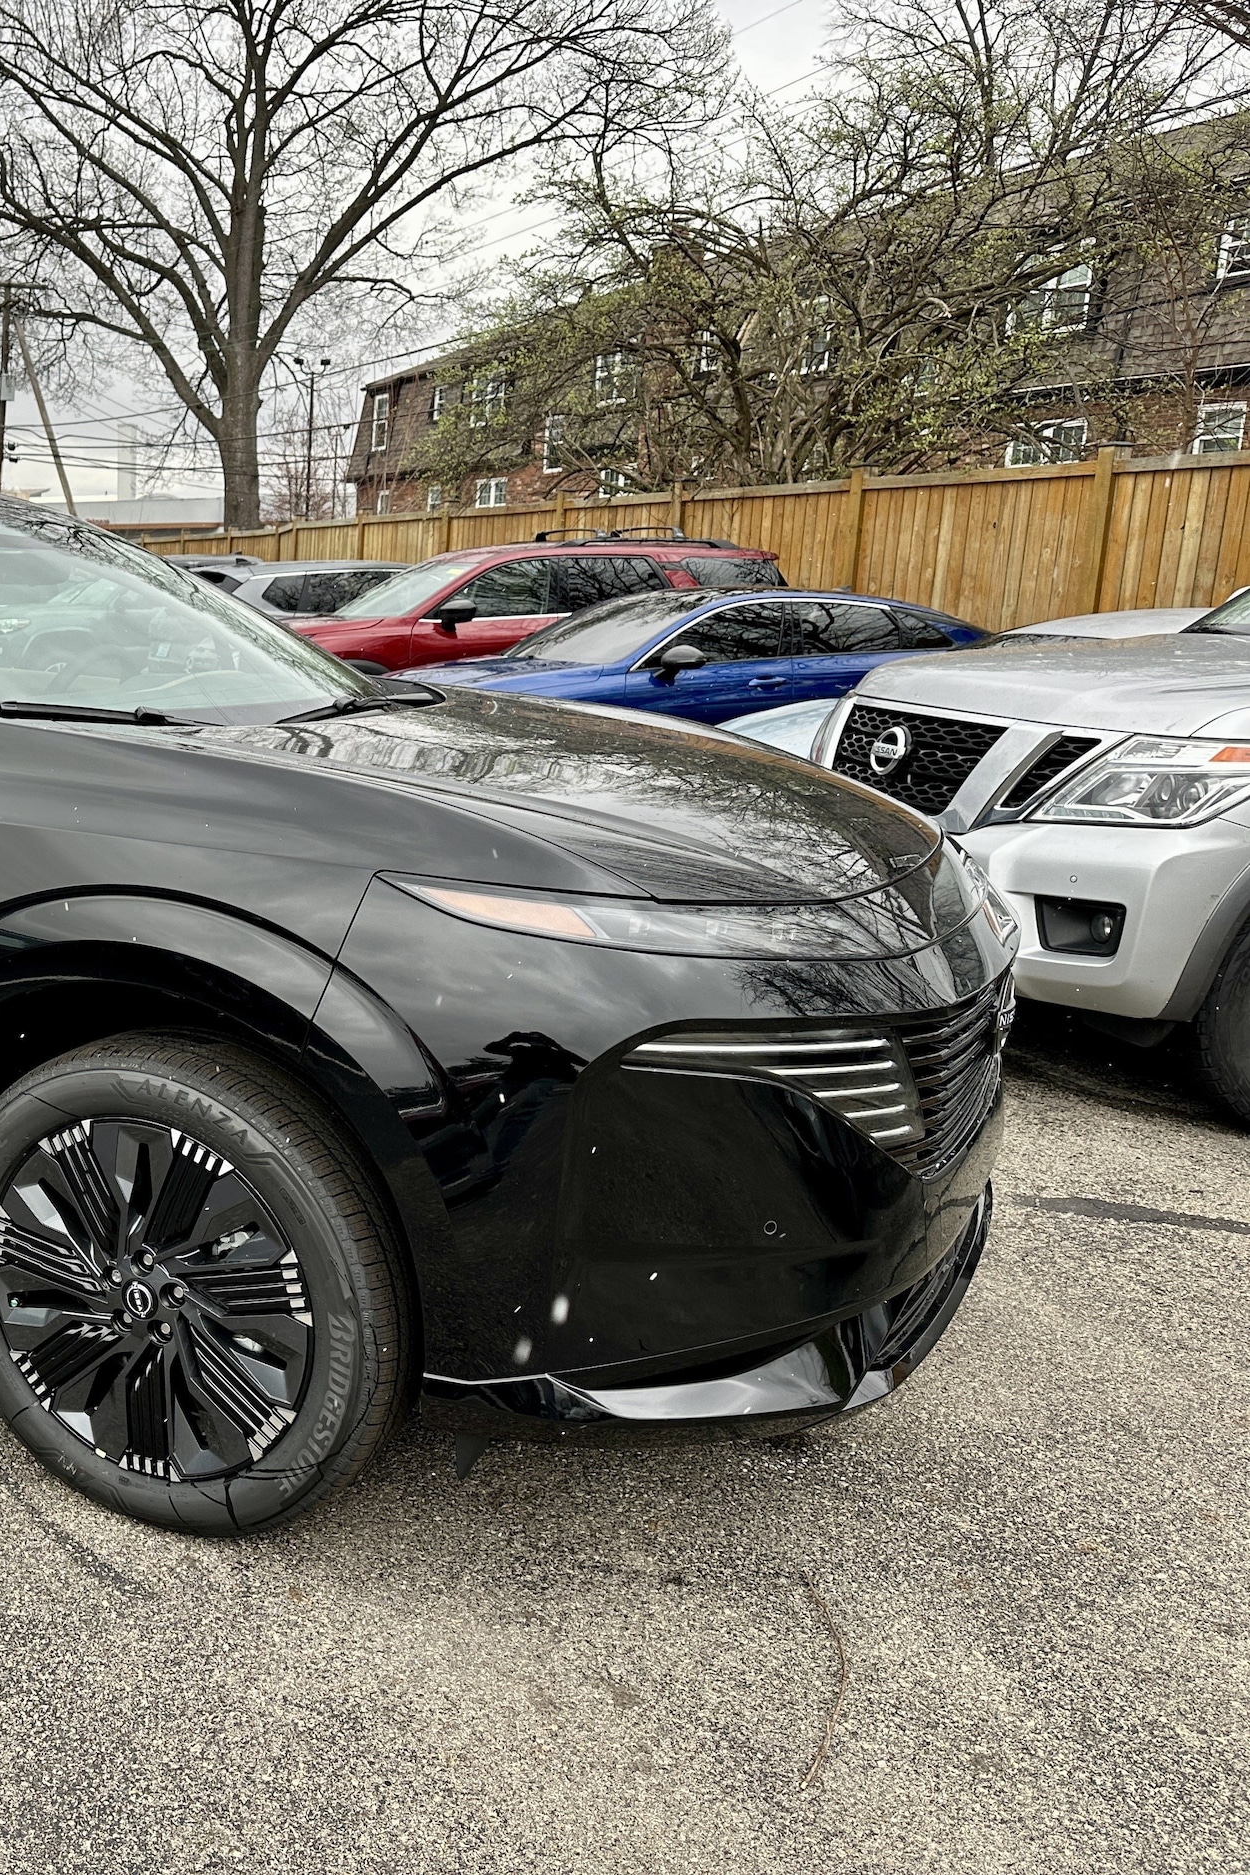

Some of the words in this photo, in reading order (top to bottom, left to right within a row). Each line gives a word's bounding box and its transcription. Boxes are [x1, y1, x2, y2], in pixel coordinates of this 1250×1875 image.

[873, 745, 898, 757] SSAN
[137, 1078, 248, 1146] ALENZA
[275, 1311, 356, 1499] BRIDGESTONE
